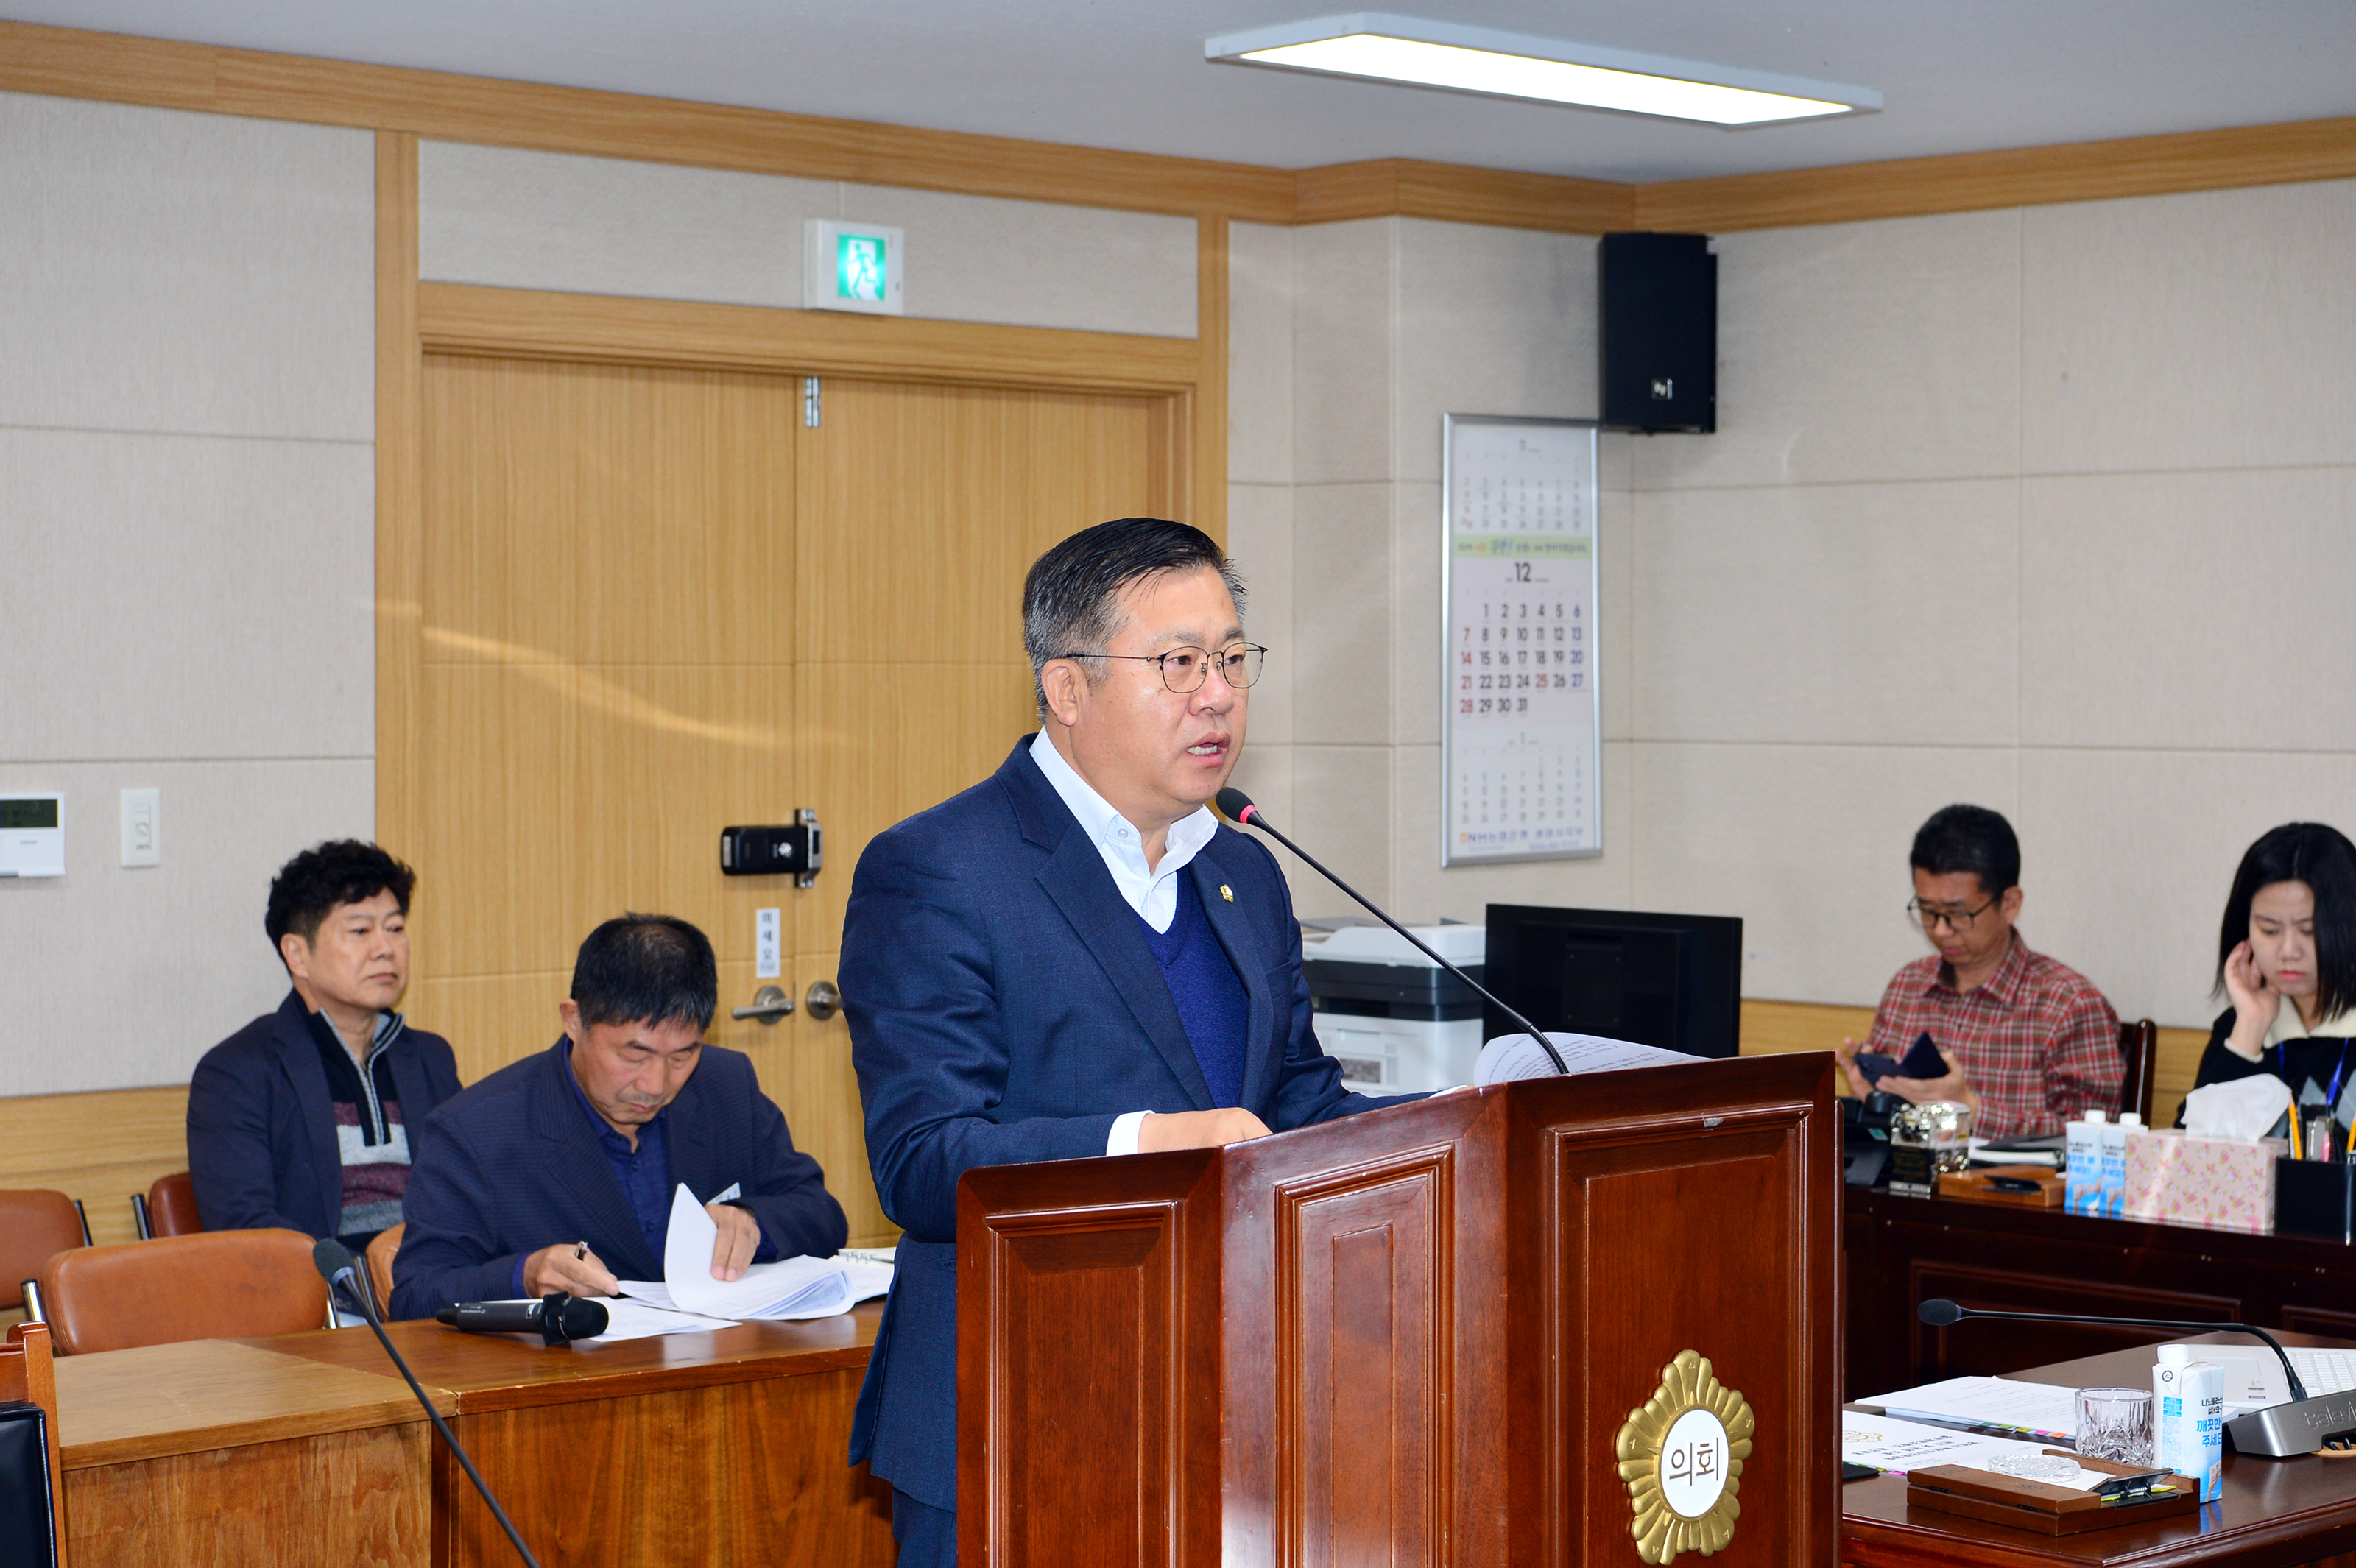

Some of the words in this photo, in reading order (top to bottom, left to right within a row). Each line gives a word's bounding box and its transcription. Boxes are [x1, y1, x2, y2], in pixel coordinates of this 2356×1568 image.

[1514, 562, 1531, 582] 12
[1484, 604, 1489, 618] 1
[1502, 604, 1508, 618] 2
[1520, 604, 1526, 618] 3
[1538, 604, 1545, 616] 4
[1556, 604, 1562, 618] 5
[1573, 605, 1581, 618] 6
[1464, 627, 1470, 640] 7
[1482, 628, 1489, 642] 8
[1500, 627, 1507, 640] 9
[1517, 627, 1528, 641] 10
[1537, 627, 1545, 640] 11
[1554, 627, 1564, 641] 12
[1572, 626, 1581, 641] 13
[1461, 652, 1472, 664] 14
[1480, 651, 1491, 665] 15
[1499, 651, 1509, 665] 16
[1517, 650, 1528, 665] 17
[1536, 650, 1546, 665] 18
[1553, 650, 1564, 663] 19
[1571, 650, 1583, 664] 20
[1461, 675, 1472, 690] 21
[1480, 675, 1492, 689] 22
[1498, 674, 1511, 689] 23
[1517, 674, 1530, 688] 24
[1536, 674, 1548, 688] 25
[1553, 674, 1566, 688] 26
[1572, 673, 1583, 688] 27
[1460, 699, 1473, 713] 28
[1479, 699, 1492, 713] 29
[1498, 698, 1511, 712] 30
[1517, 697, 1528, 712] 31
[2304, 1400, 2356, 1430] televi
[2195, 1417, 2221, 1433] 깨끗한
[1669, 1437, 1718, 1486] 의회
